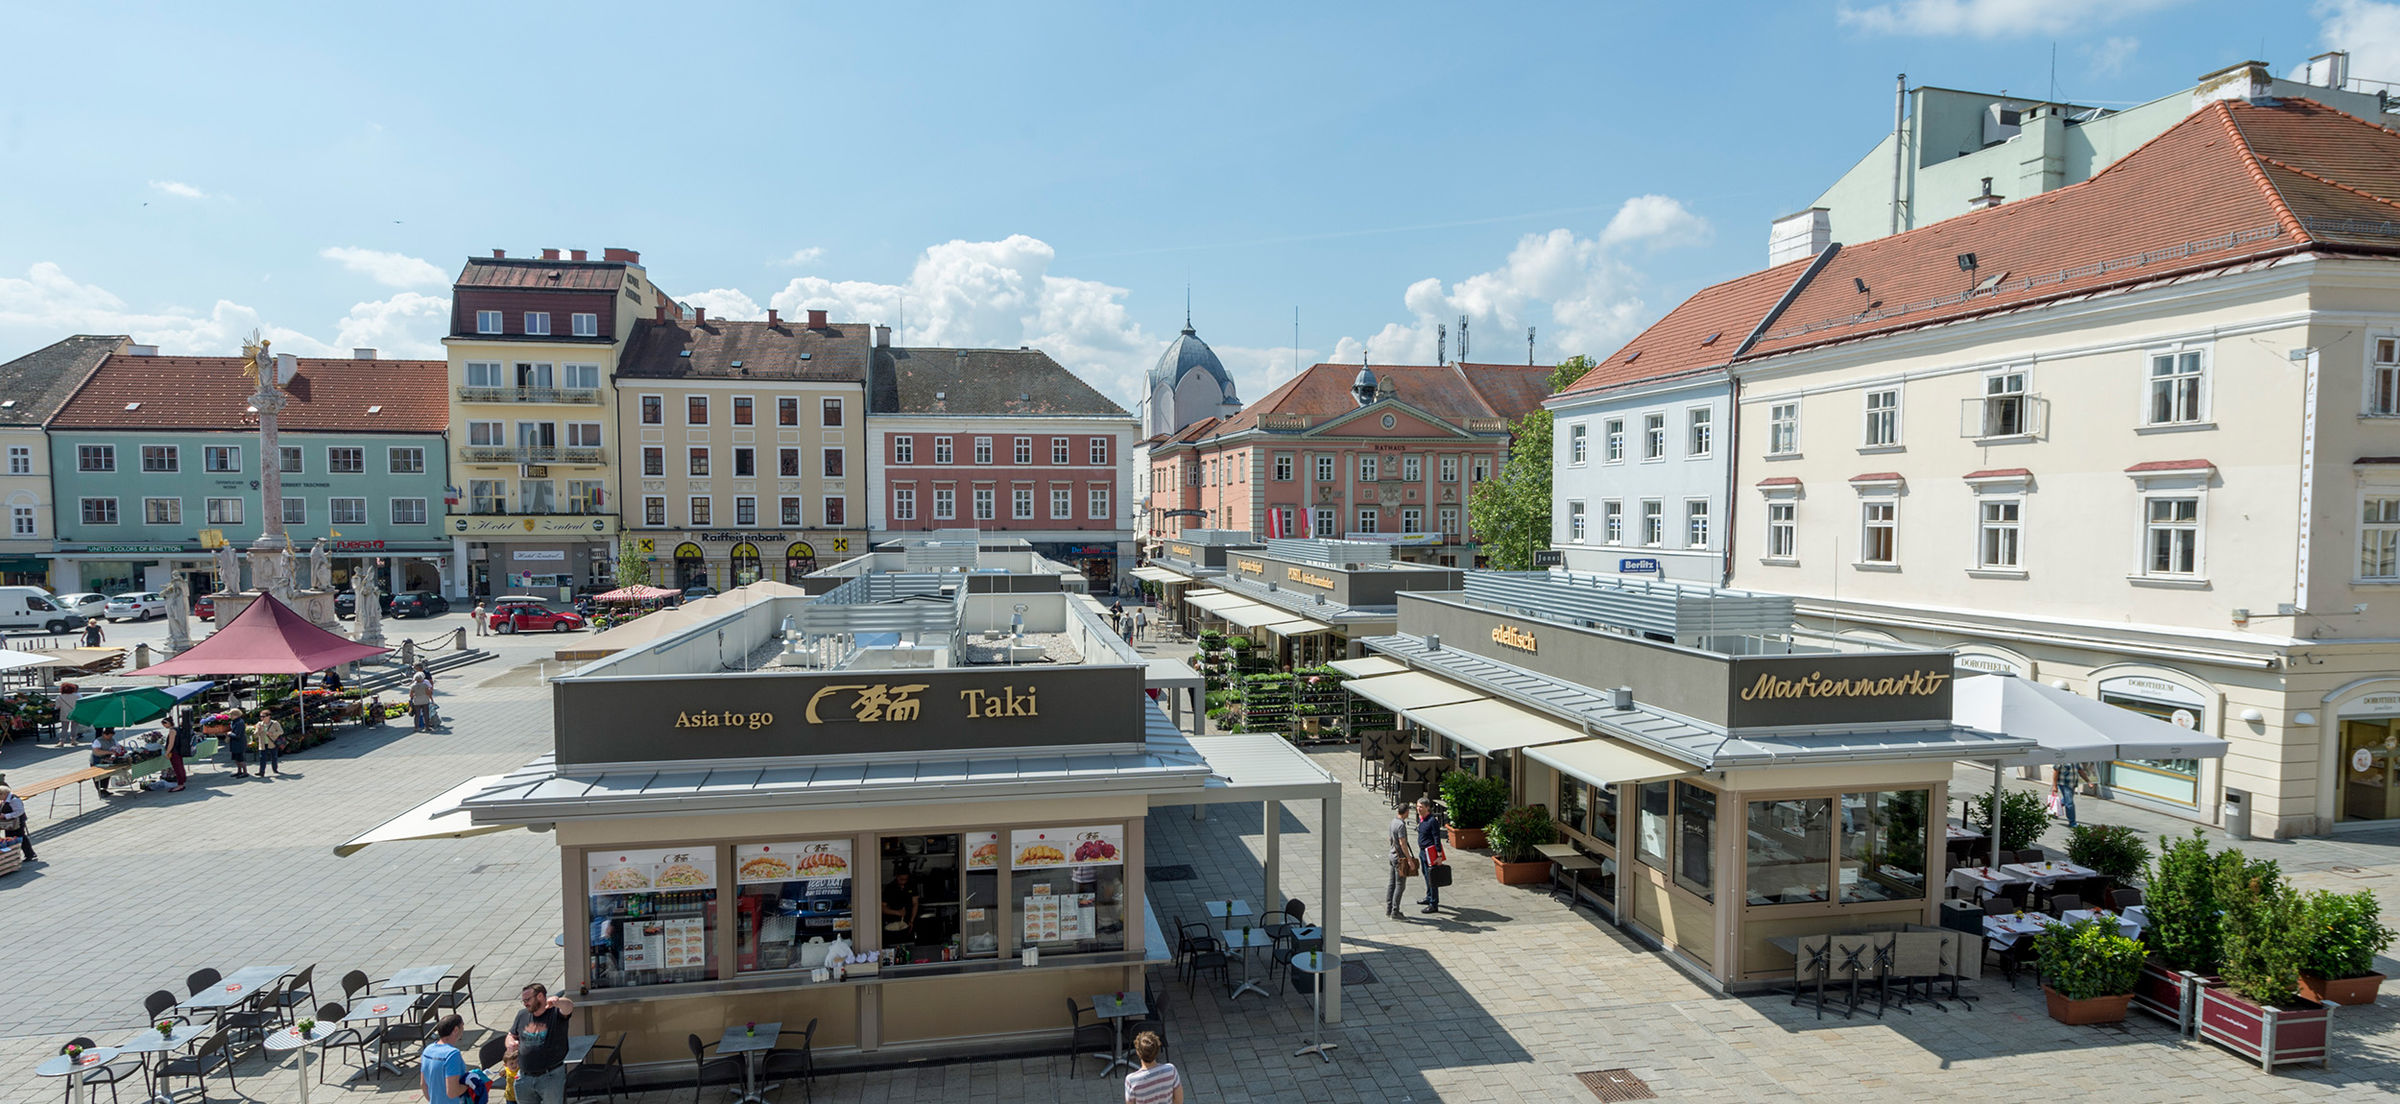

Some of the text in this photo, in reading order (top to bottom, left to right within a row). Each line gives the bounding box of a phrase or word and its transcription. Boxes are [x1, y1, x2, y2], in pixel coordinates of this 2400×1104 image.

[529, 466, 547, 477] HOTEL
[473, 520, 517, 530] Hotel
[702, 532, 787, 542] Raiffeisenbank
[1538, 554, 1560, 563] Jones
[1625, 560, 1654, 569] Berlitz
[1491, 624, 1537, 653] edelfisch
[1960, 658, 2011, 673] DOROTHEUM
[1741, 670, 1950, 701] Marienmarkt
[2128, 679, 2175, 692] DOROTHEUM
[960, 685, 1039, 719] Taki
[675, 710, 774, 730] Asia to go
